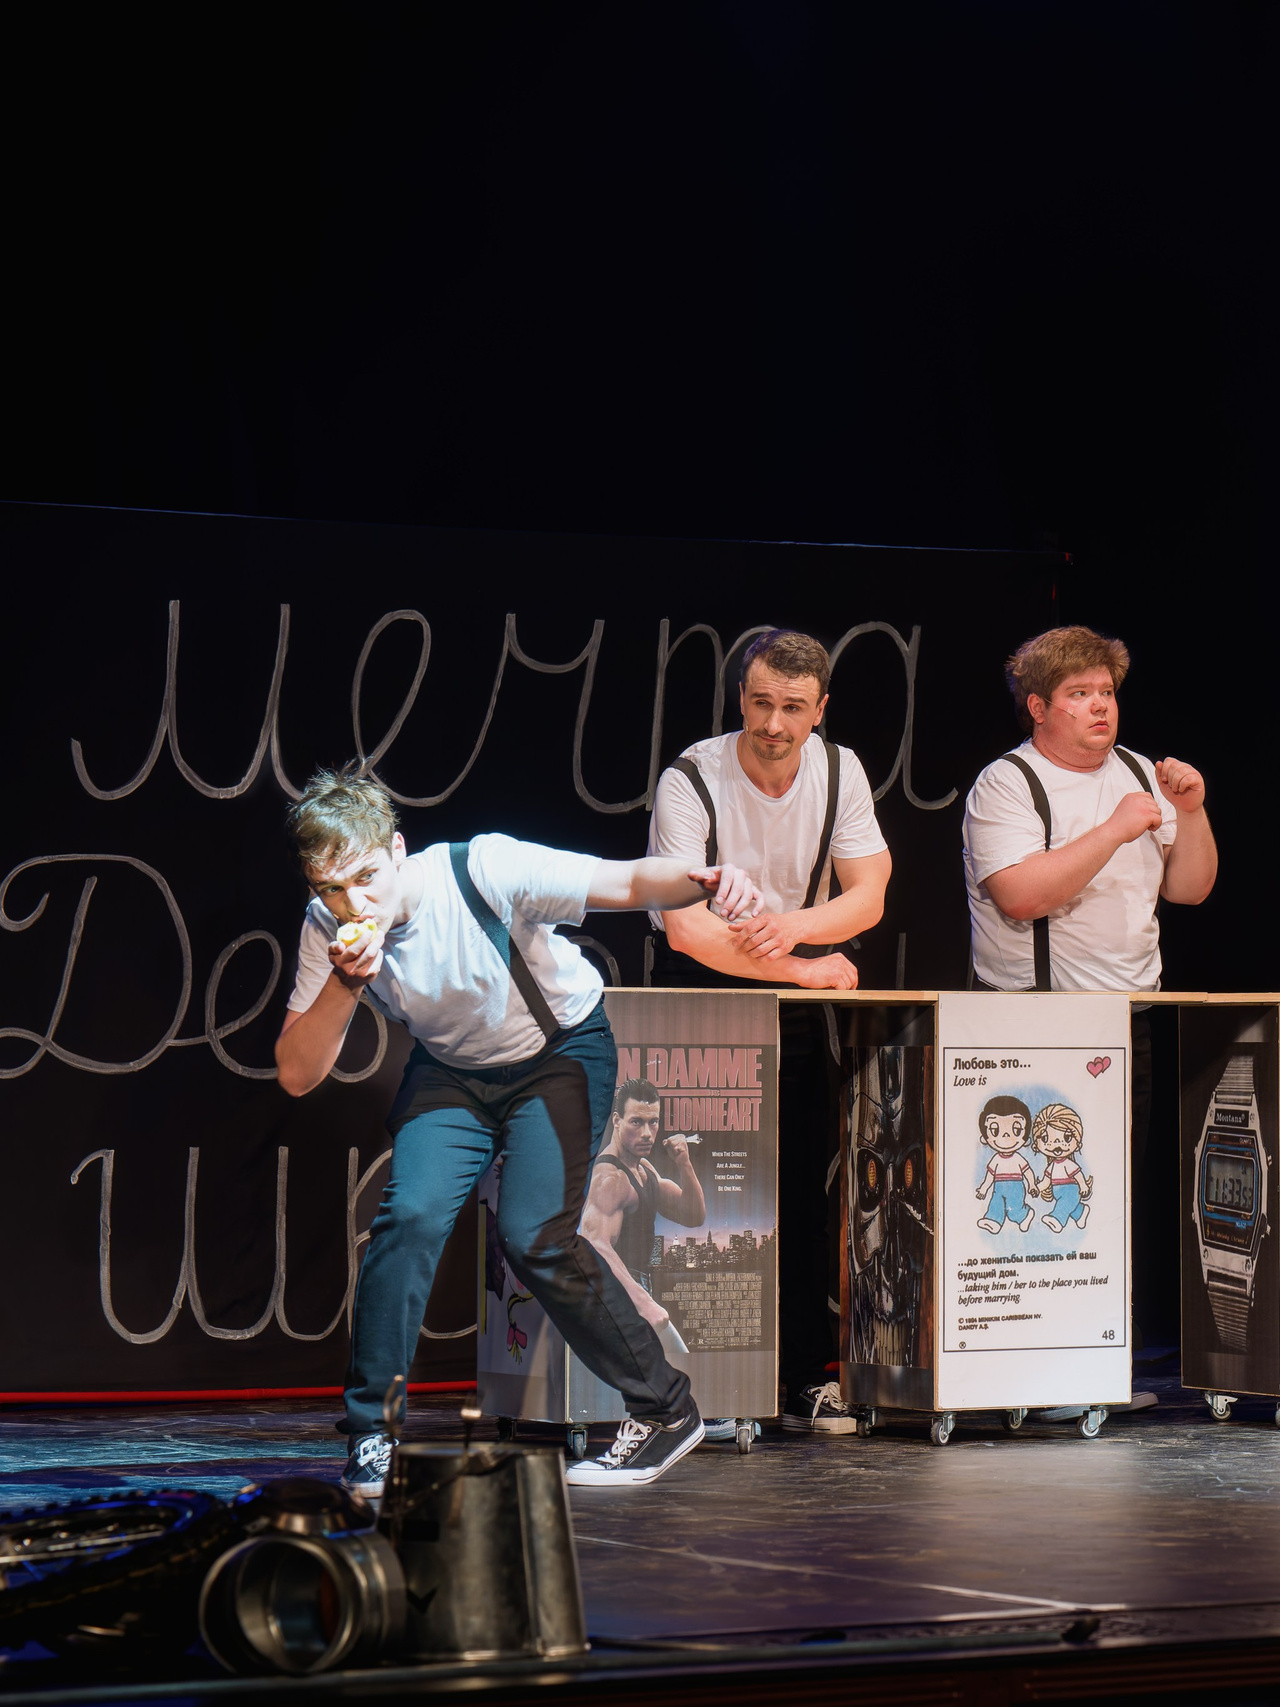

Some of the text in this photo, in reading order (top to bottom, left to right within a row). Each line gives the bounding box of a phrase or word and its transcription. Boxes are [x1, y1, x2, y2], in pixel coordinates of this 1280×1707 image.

[647, 1047, 763, 1088] DAMME
[953, 1057, 1031, 1070] Любовь это...
[953, 1075, 987, 1087] Love is
[664, 1097, 763, 1132] LIONHEART
[980, 1254, 1024, 1266] женитьбы
[1025, 1253, 1064, 1263] показать
[1066, 1252, 1077, 1260] ей
[1079, 1251, 1096, 1260] ваш
[958, 1269, 1019, 1281] будущий дом.
[991, 1282, 1007, 1291] him
[1028, 1280, 1037, 1289] to
[1038, 1279, 1051, 1288] the
[1051, 1278, 1072, 1290] place
[1074, 1278, 1088, 1289] you
[1090, 1276, 1109, 1285] lived
[958, 1293, 1021, 1307] before marrying.
[1102, 1330, 1115, 1340] 48
